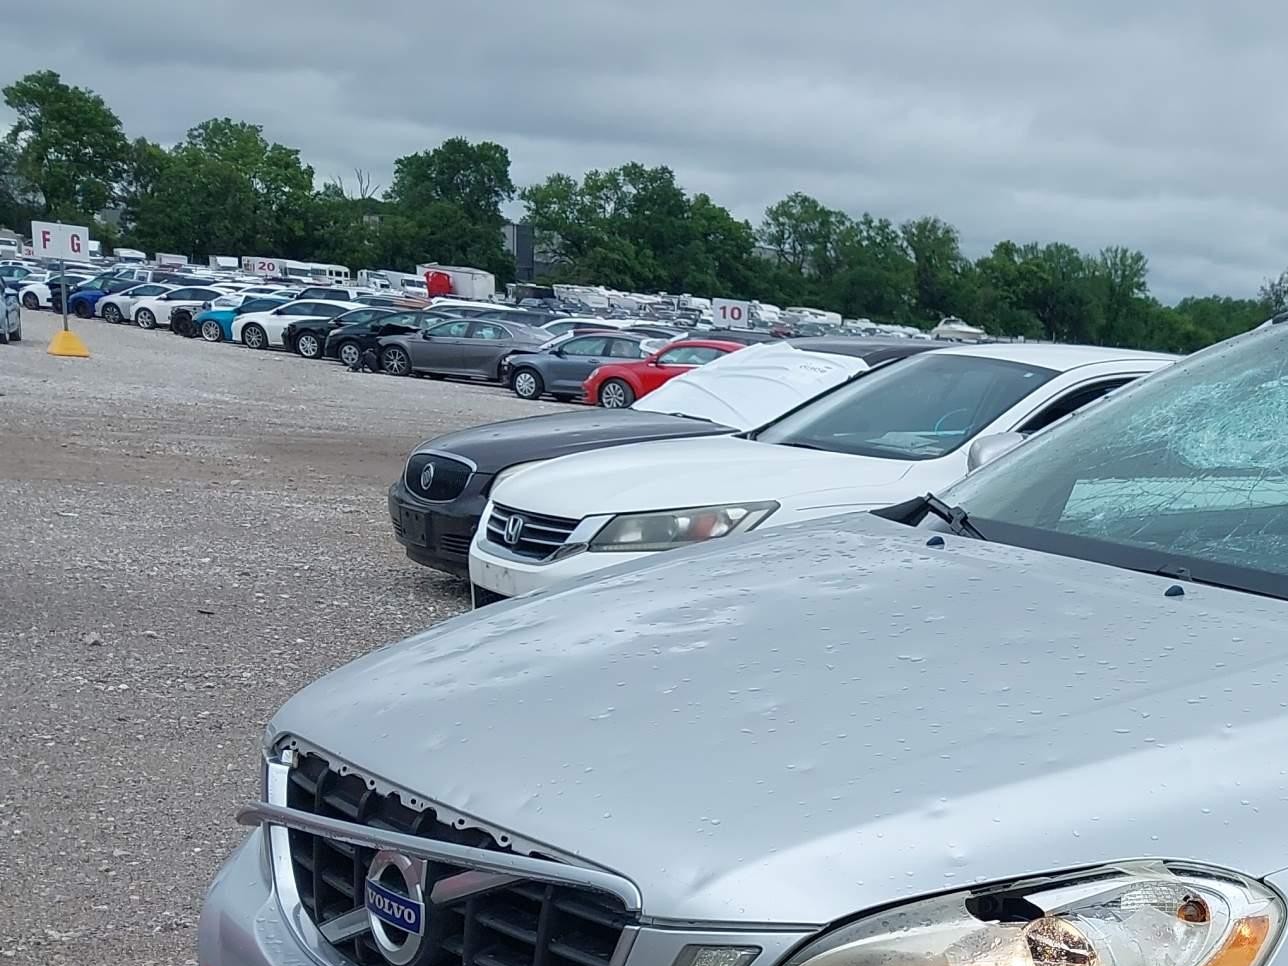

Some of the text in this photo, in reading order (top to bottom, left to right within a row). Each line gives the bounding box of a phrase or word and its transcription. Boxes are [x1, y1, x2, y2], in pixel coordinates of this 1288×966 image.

[42, 230, 81, 254] F G
[258, 261, 276, 272] 20
[719, 305, 742, 321] 10
[367, 888, 416, 924] VOLVO
